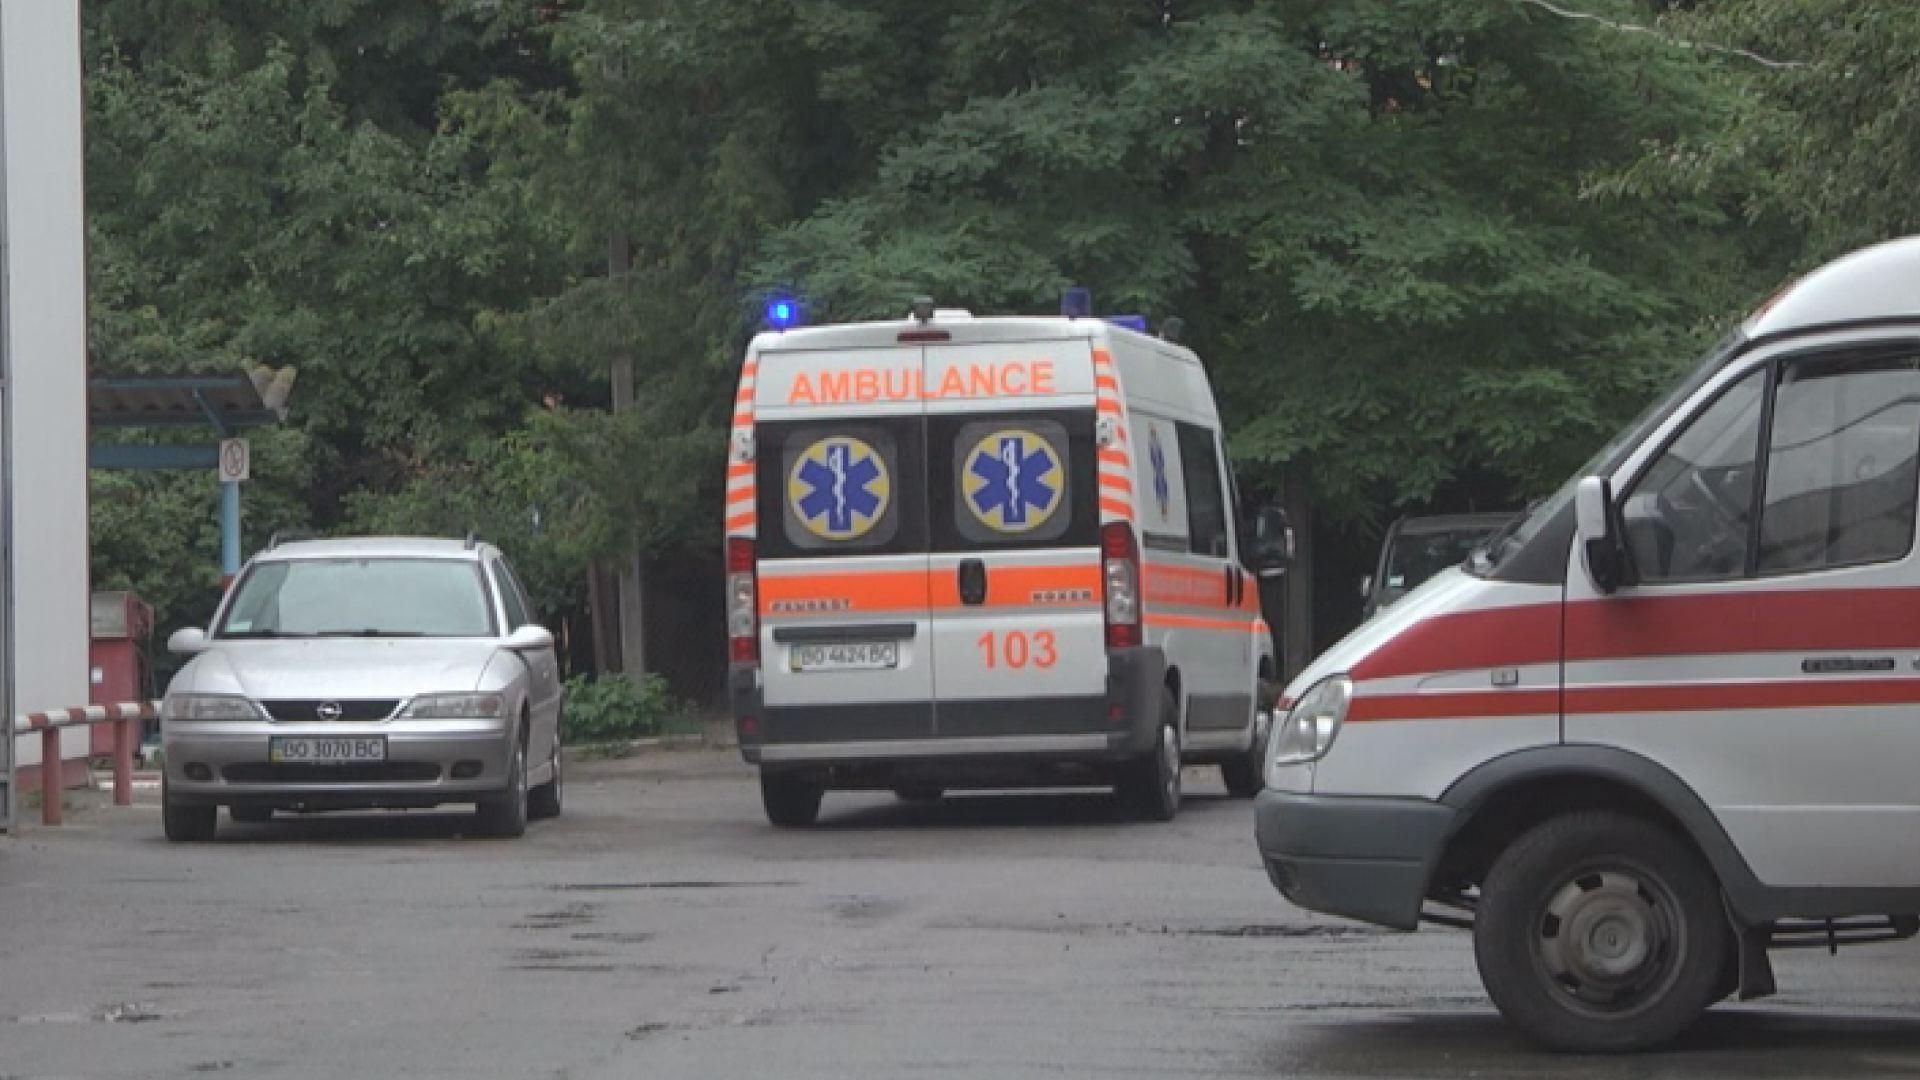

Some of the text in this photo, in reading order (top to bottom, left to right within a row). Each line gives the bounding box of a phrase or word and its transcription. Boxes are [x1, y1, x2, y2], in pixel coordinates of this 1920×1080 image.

[789, 361, 1055, 403] AMBULANCE
[829, 645, 864, 663] 4624
[869, 643, 893, 662] BC
[977, 630, 1057, 669] 103
[314, 741, 350, 757] 3070
[355, 741, 381, 757] BC
